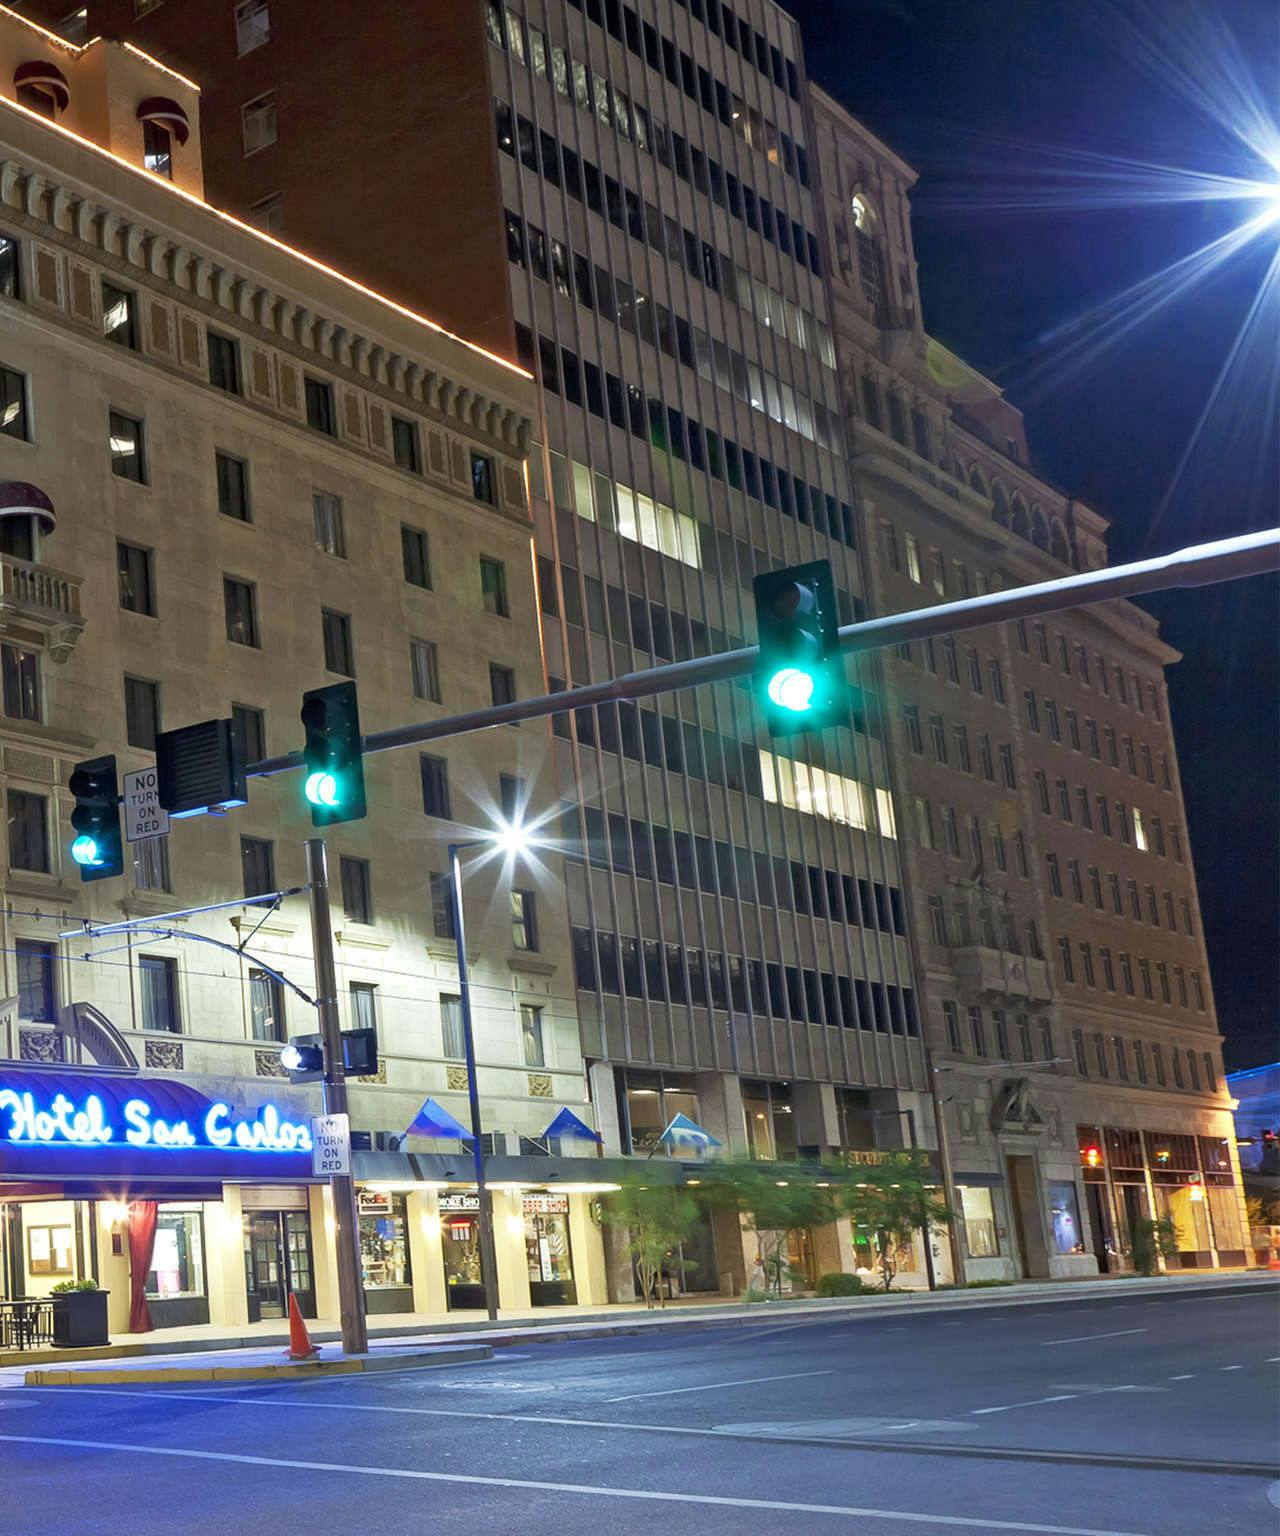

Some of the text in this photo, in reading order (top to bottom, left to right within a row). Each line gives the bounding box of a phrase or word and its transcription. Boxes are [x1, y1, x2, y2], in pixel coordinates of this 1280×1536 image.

[135, 774, 156, 791] NO
[138, 806, 155, 819] ON
[136, 820, 160, 835] RED
[124, 1098, 195, 1146] San
[204, 1102, 313, 1149] Carlos
[317, 1136, 344, 1146] TURN
[324, 1148, 338, 1158] ON
[321, 1161, 342, 1171] RED
[360, 1194, 389, 1204] FedEx
[438, 1195, 480, 1205] MOKE SHO
[523, 1200, 568, 1212] RBER SHOP
